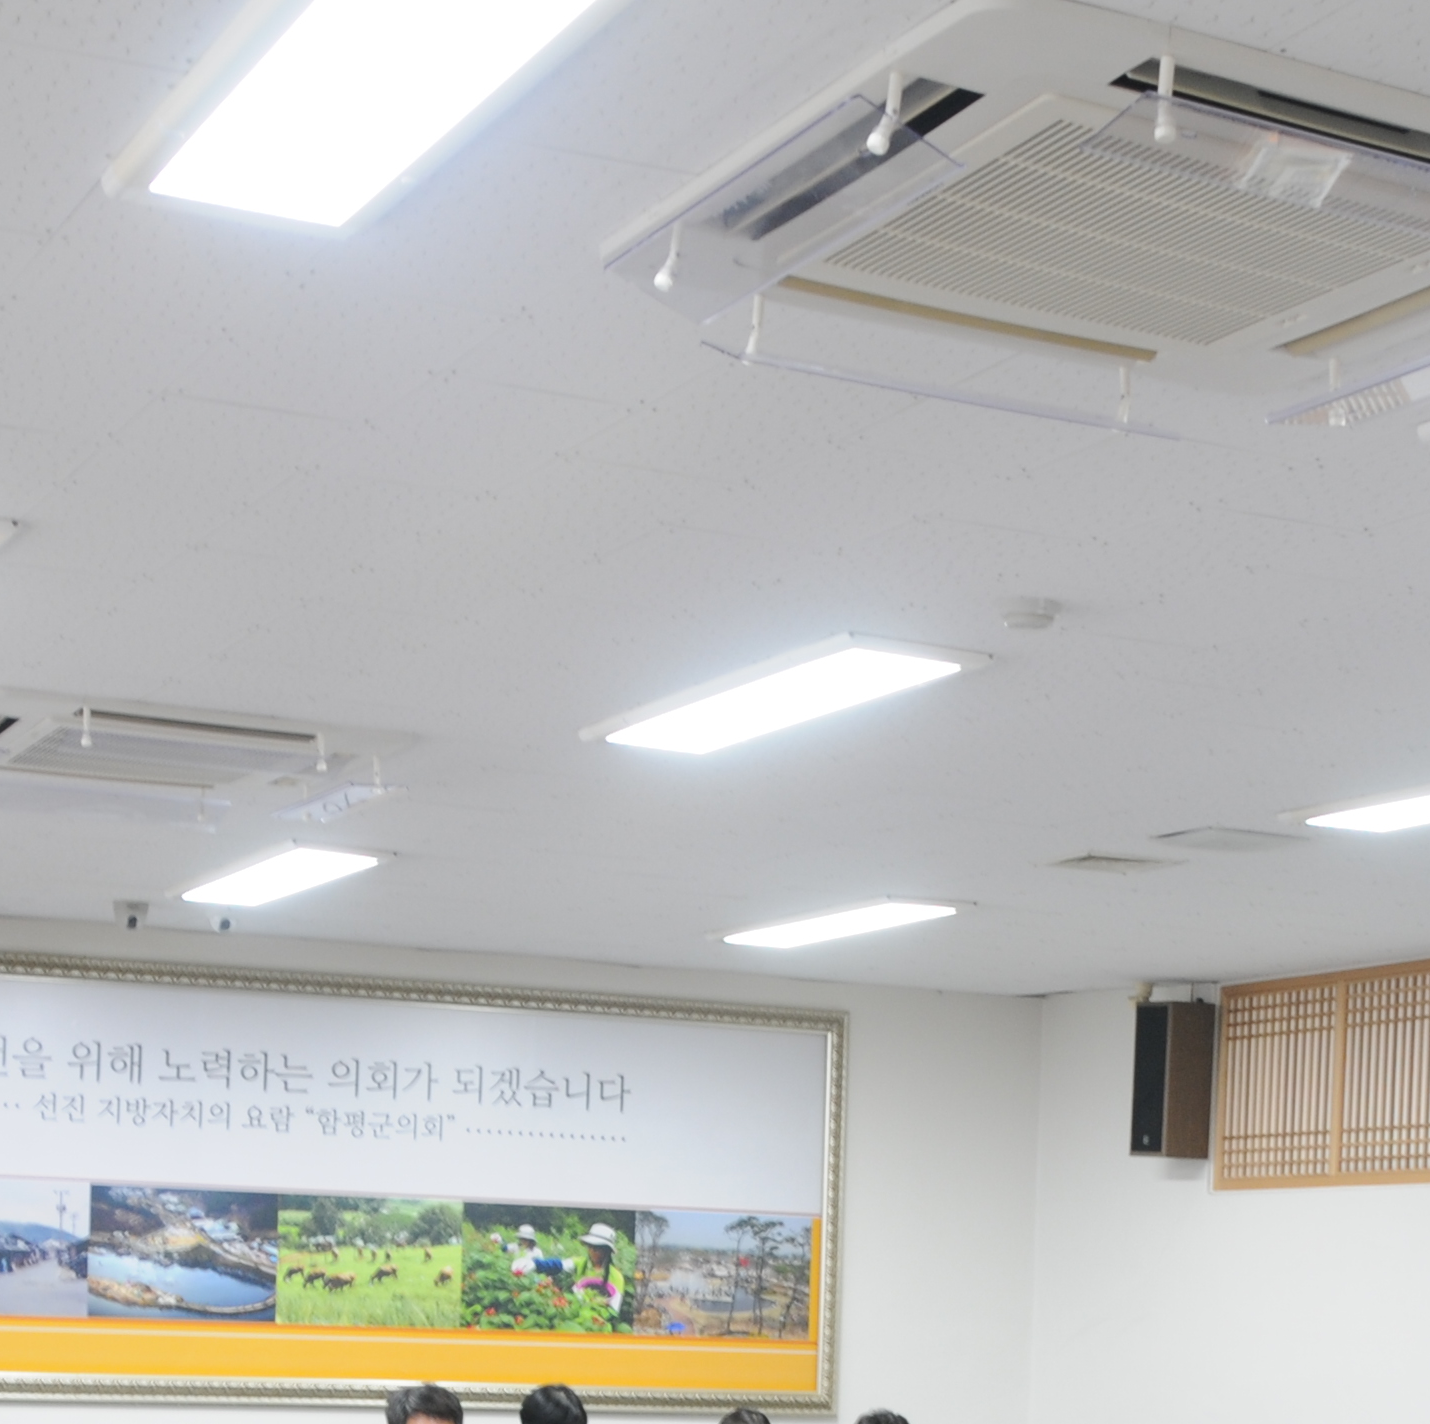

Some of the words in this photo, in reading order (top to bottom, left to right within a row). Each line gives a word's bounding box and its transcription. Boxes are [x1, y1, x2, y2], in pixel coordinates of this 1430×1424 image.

[67, 1040, 143, 1085] 위해
[157, 1048, 314, 1095] 노력하는
[327, 1057, 439, 1103] 의회가
[451, 1064, 632, 1114] 되겠습니다
[33, 1091, 86, 1124] 선진
[98, 1095, 231, 1131] 지방자치의
[241, 1104, 295, 1134] 요람
